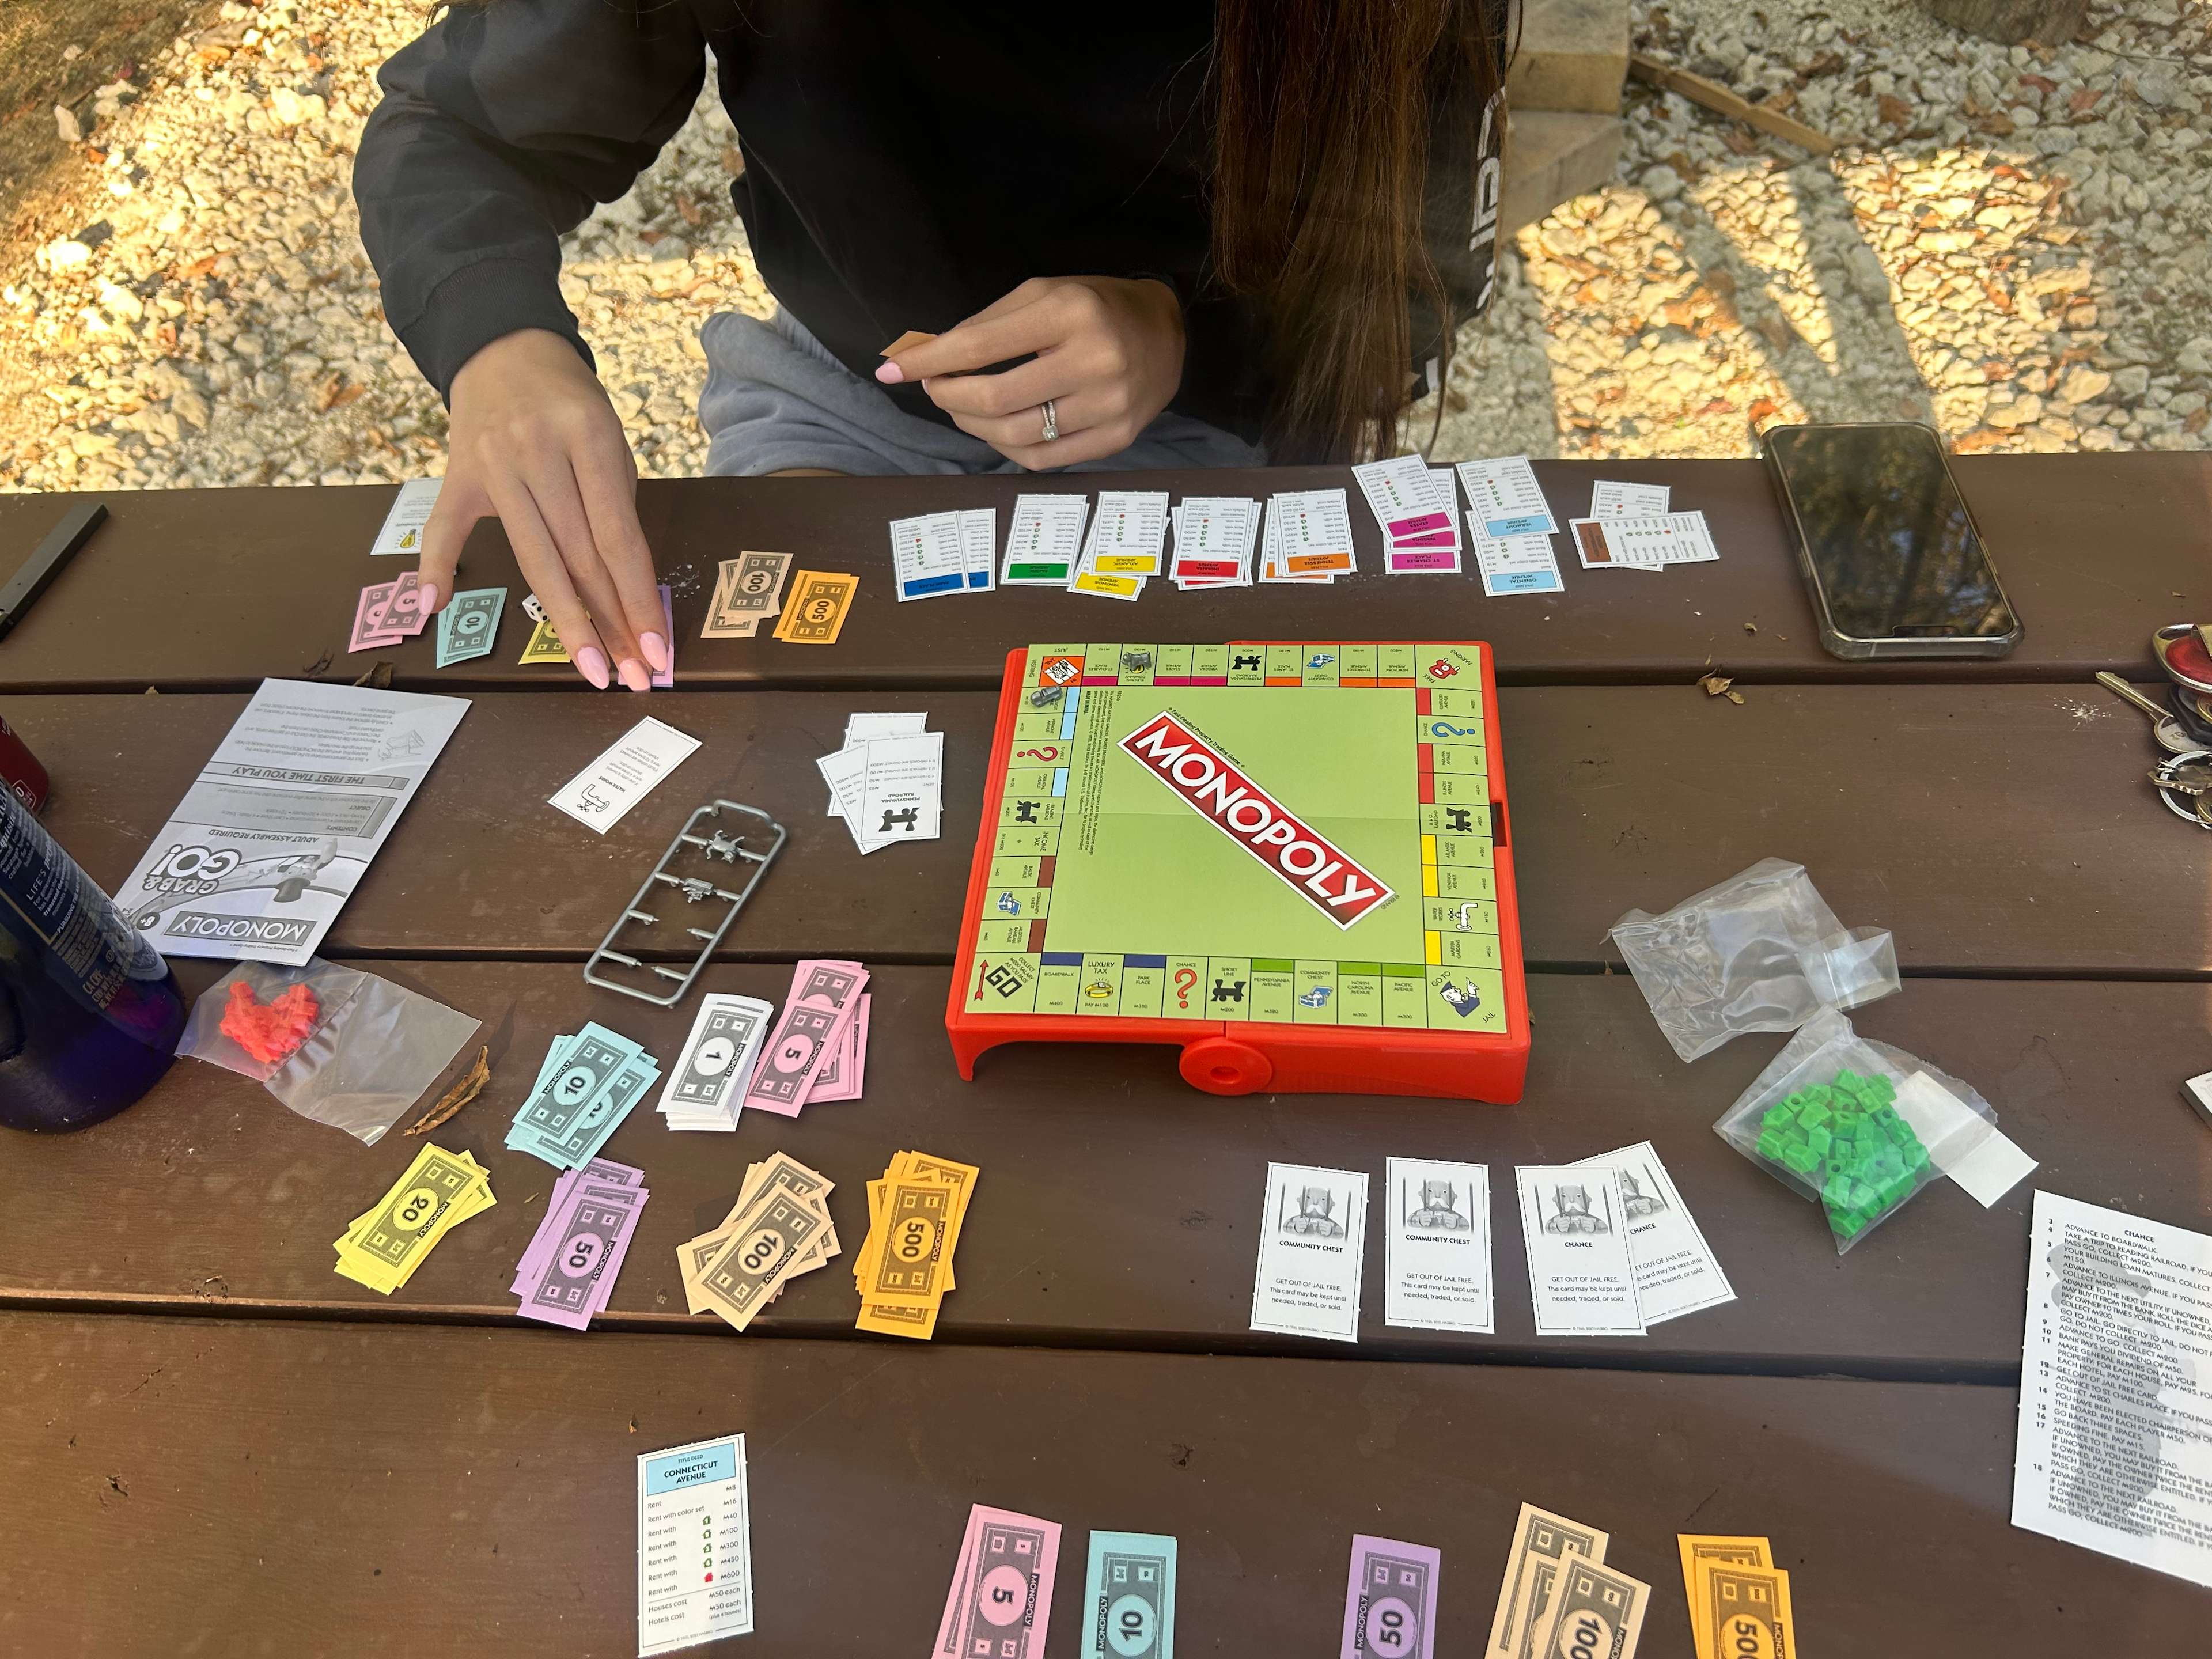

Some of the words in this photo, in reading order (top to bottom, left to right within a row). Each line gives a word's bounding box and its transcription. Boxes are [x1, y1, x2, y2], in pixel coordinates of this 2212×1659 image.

[747, 573, 765, 592] 100
[812, 600, 830, 620] 500
[465, 616, 481, 628] 10
[1449, 649, 1473, 665] PARKING
[1423, 673, 1436, 683] FREE
[1172, 710, 1196, 729] Fast-Dealing
[1195, 728, 1213, 743] Property
[1213, 742, 1228, 756] Trading
[1228, 754, 1240, 765] Game
[232, 767, 263, 777] PLAY
[262, 770, 287, 779] YOU
[287, 772, 314, 781] TIME
[314, 774, 345, 783] FIRST
[344, 776, 366, 785] THE
[1134, 725, 1376, 907] MONOPOLY
[209, 830, 249, 839] REQUIRED
[250, 832, 291, 841] ASSEMBLY
[1040, 831, 1049, 852] INCOME
[172, 915, 308, 942] MONOPOLY
[986, 965, 1023, 998] GO
[1431, 978, 1442, 987] GO
[1440, 971, 1451, 979] TO
[1482, 1012, 1496, 1023] JAIL
[706, 1051, 722, 1062] 1
[726, 1044, 745, 1076] MONOPOLY
[785, 1047, 801, 1060] 5
[802, 1041, 823, 1075] MONOPOLY
[544, 1061, 571, 1094] MONOPOLY
[563, 1075, 585, 1095] 10
[402, 1193, 429, 1222] 20
[418, 1202, 449, 1237] MONOPOLY
[1630, 1223, 1656, 1235] CHANCE
[2124, 1230, 2154, 1243] CHANCE
[902, 1222, 925, 1258] 500
[931, 1222, 944, 1262] MONOPOLY
[1279, 1240, 1321, 1251] COMMUNITY
[1322, 1245, 1343, 1253] CHEST
[1405, 1234, 1448, 1243] COMMUNITY
[2065, 1224, 2099, 1237] ADVANCE
[2112, 1236, 2158, 1254] BOARDWALK.
[569, 1240, 596, 1268] 50
[744, 1233, 778, 1270] 100
[2065, 1231, 2082, 1241] TAKE
[2090, 1238, 2105, 1247] TRIP
[2105, 1242, 2115, 1250] TO
[2117, 1245, 2149, 1260] READING
[2150, 1255, 2188, 1271] RAILROAD.
[592, 1241, 614, 1280] MONOPOLY
[764, 1247, 796, 1283] MONOPOLY
[1404, 1292, 1429, 1300] needed,
[1430, 1294, 1453, 1302] traded,
[2054, 1408, 2067, 1417] GO
[2068, 1412, 2088, 1425] BACK
[2090, 1419, 2112, 1431] THREE
[2114, 1426, 2143, 1440] SPACES.
[2054, 1417, 2090, 1434] SPEEDING
[2092, 1429, 2109, 1440] FINE.
[2111, 1434, 2126, 1444] PAY
[2126, 1440, 2145, 1450] M15.
[664, 1460, 718, 1478] CONNECTICUT
[676, 1471, 706, 1484] AVENUE
[647, 1501, 662, 1509] Rent
[647, 1514, 662, 1523] Rent
[662, 1512, 677, 1520] with
[677, 1508, 694, 1517] color
[648, 1529, 662, 1537] Rent
[662, 1526, 677, 1534] with
[648, 1543, 662, 1552] Rent
[663, 1540, 677, 1548] with
[648, 1558, 662, 1567] Rent
[663, 1555, 677, 1563] with
[991, 1588, 1014, 1605] 5
[1024, 1574, 1039, 1626] MONOPOLY
[648, 1603, 672, 1613] Houses
[673, 1599, 688, 1607] cost
[648, 1616, 669, 1626] Hotels
[670, 1612, 685, 1621] cost
[1097, 1597, 1108, 1649] MONOPOLY
[1118, 1611, 1144, 1642] 10
[1357, 1597, 1368, 1647] MONOPOLY
[1380, 1609, 1404, 1647] 50
